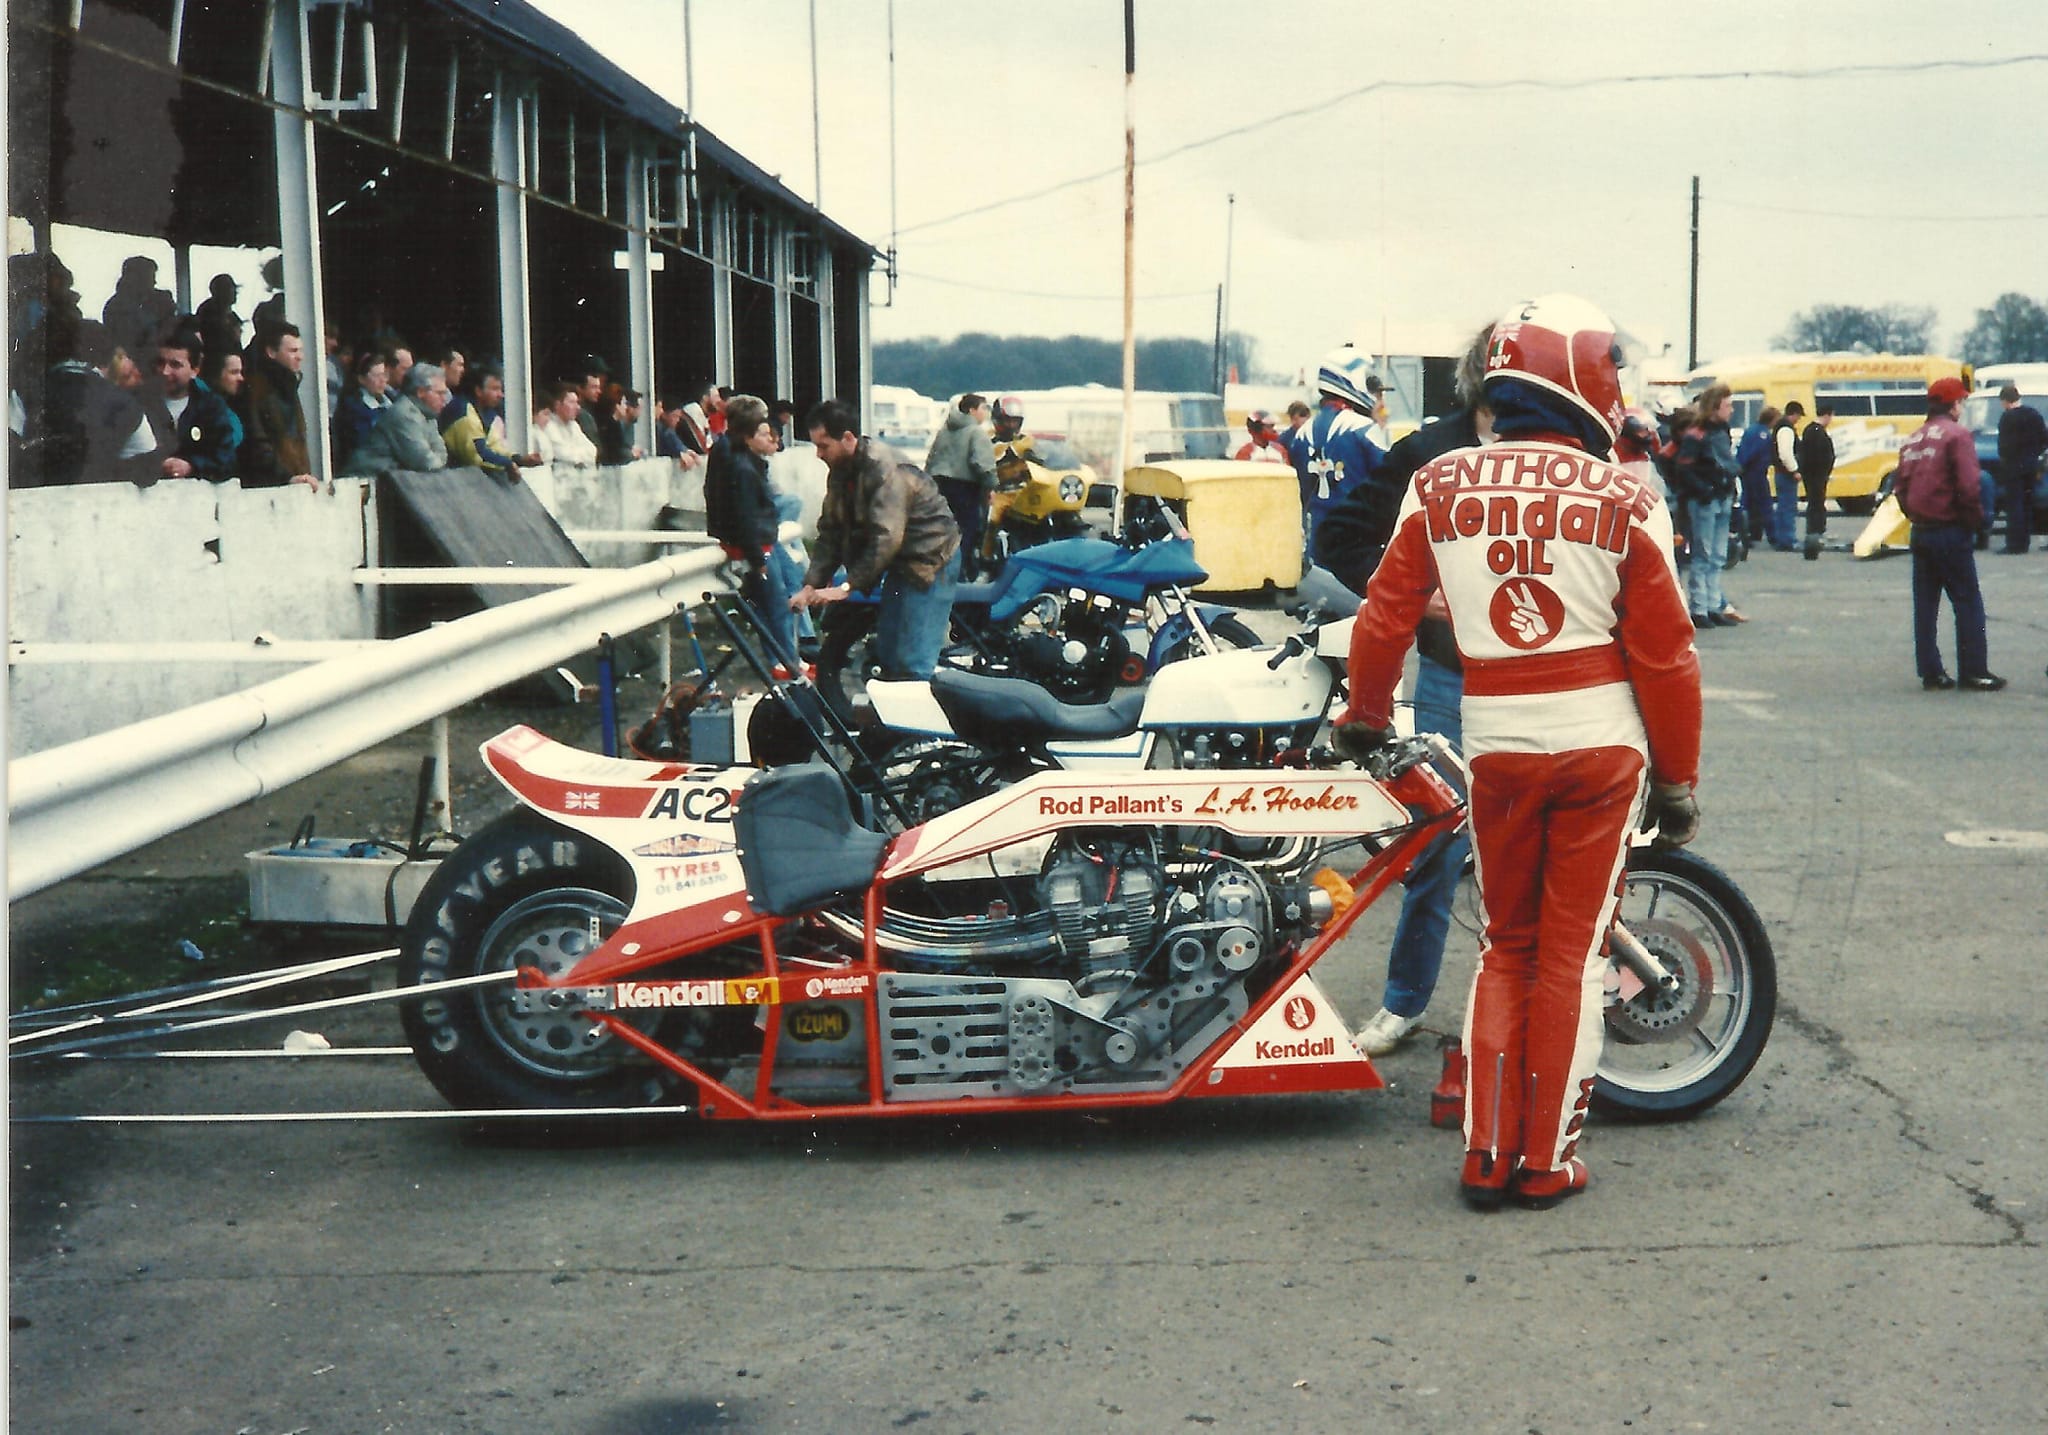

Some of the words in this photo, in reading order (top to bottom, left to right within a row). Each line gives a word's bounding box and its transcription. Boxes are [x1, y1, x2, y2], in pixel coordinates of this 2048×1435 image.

[1415, 453, 1660, 523] PENTHOUSE
[1425, 491, 1631, 554] Kendall
[1487, 539, 1553, 575] OIL
[648, 787, 732, 823] AC2
[1039, 796, 1083, 815] Rod
[1090, 794, 1183, 814] Pallant's
[1195, 786, 1257, 816] L.A.
[1263, 785, 1361, 813] Hooker
[656, 861, 721, 881] TYRES
[617, 980, 726, 1007] Kendall
[823, 976, 869, 989] Kendall
[796, 1012, 843, 1035] IZUMI
[1256, 1037, 1335, 1059] Kendall
